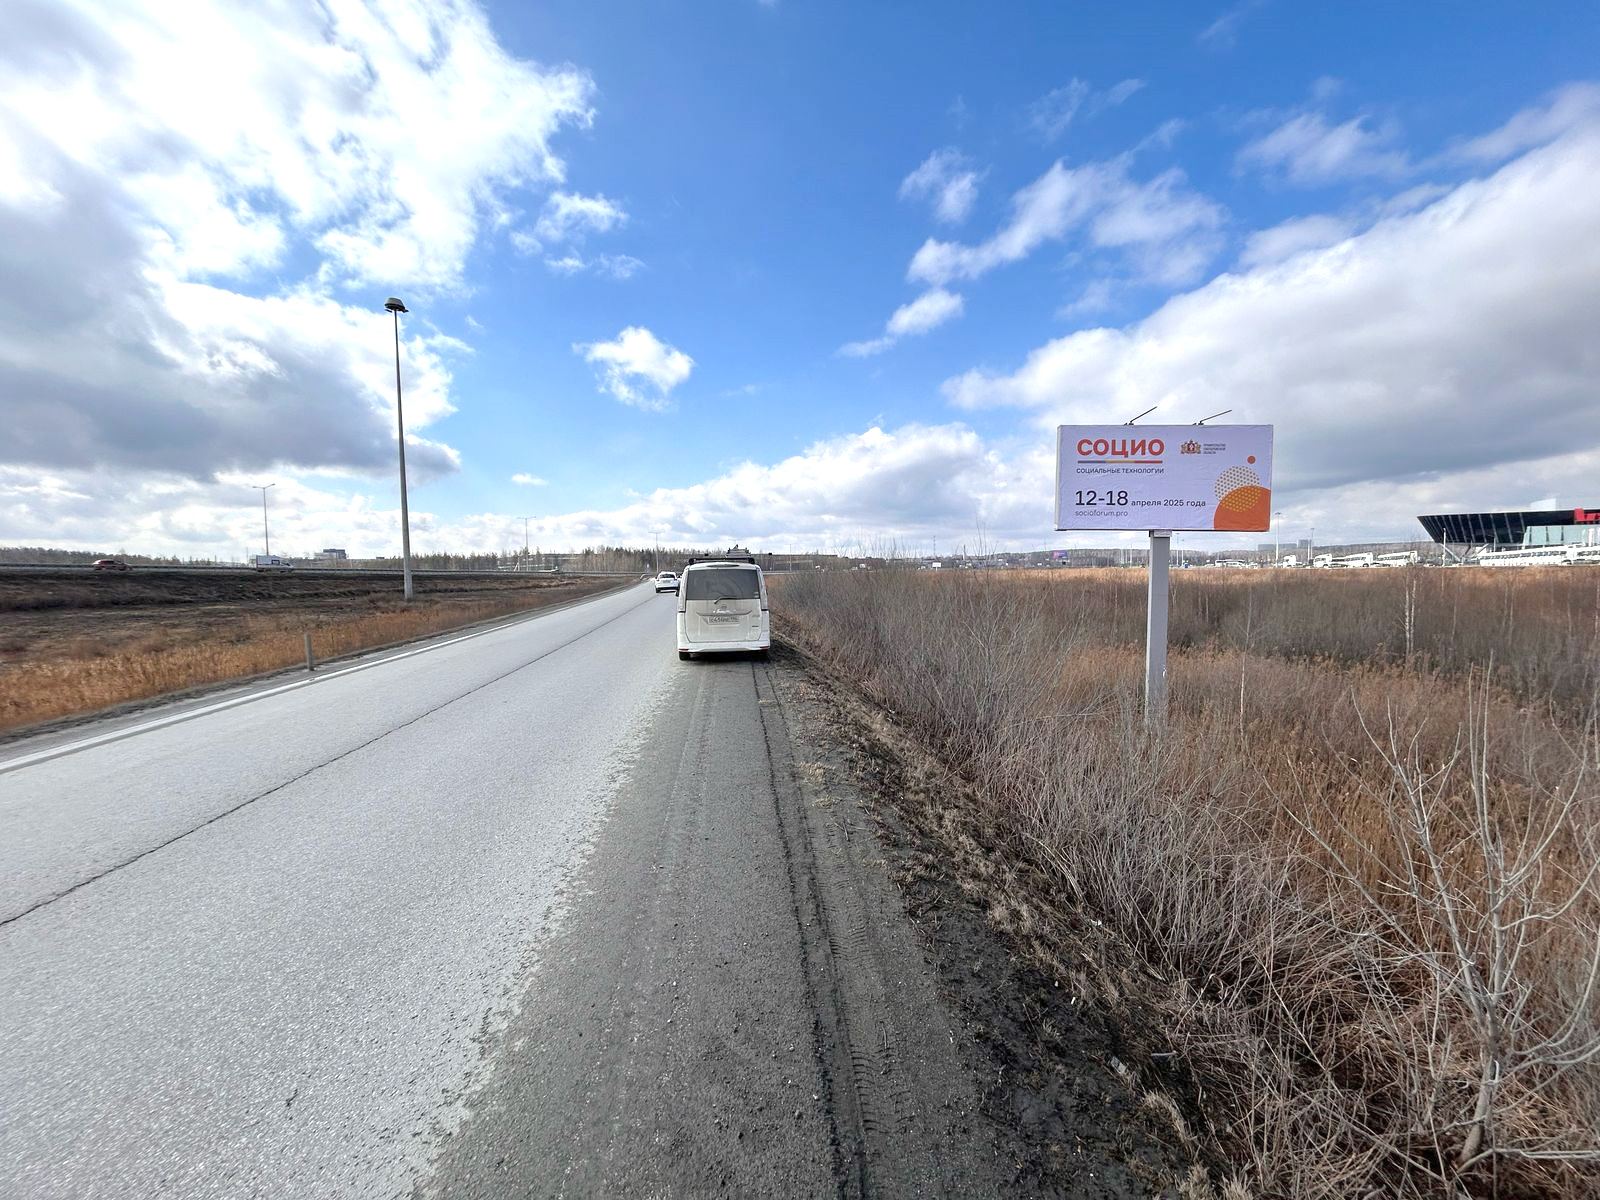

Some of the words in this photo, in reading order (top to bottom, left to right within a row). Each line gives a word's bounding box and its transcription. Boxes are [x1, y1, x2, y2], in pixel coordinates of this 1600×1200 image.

[1077, 439, 1165, 458] СОЦИО
[1075, 490, 1128, 506] 12-18
[1131, 499, 1161, 507] апреля
[1163, 499, 1184, 507] 2025
[1075, 509, 1128, 517] socioforum.pro
